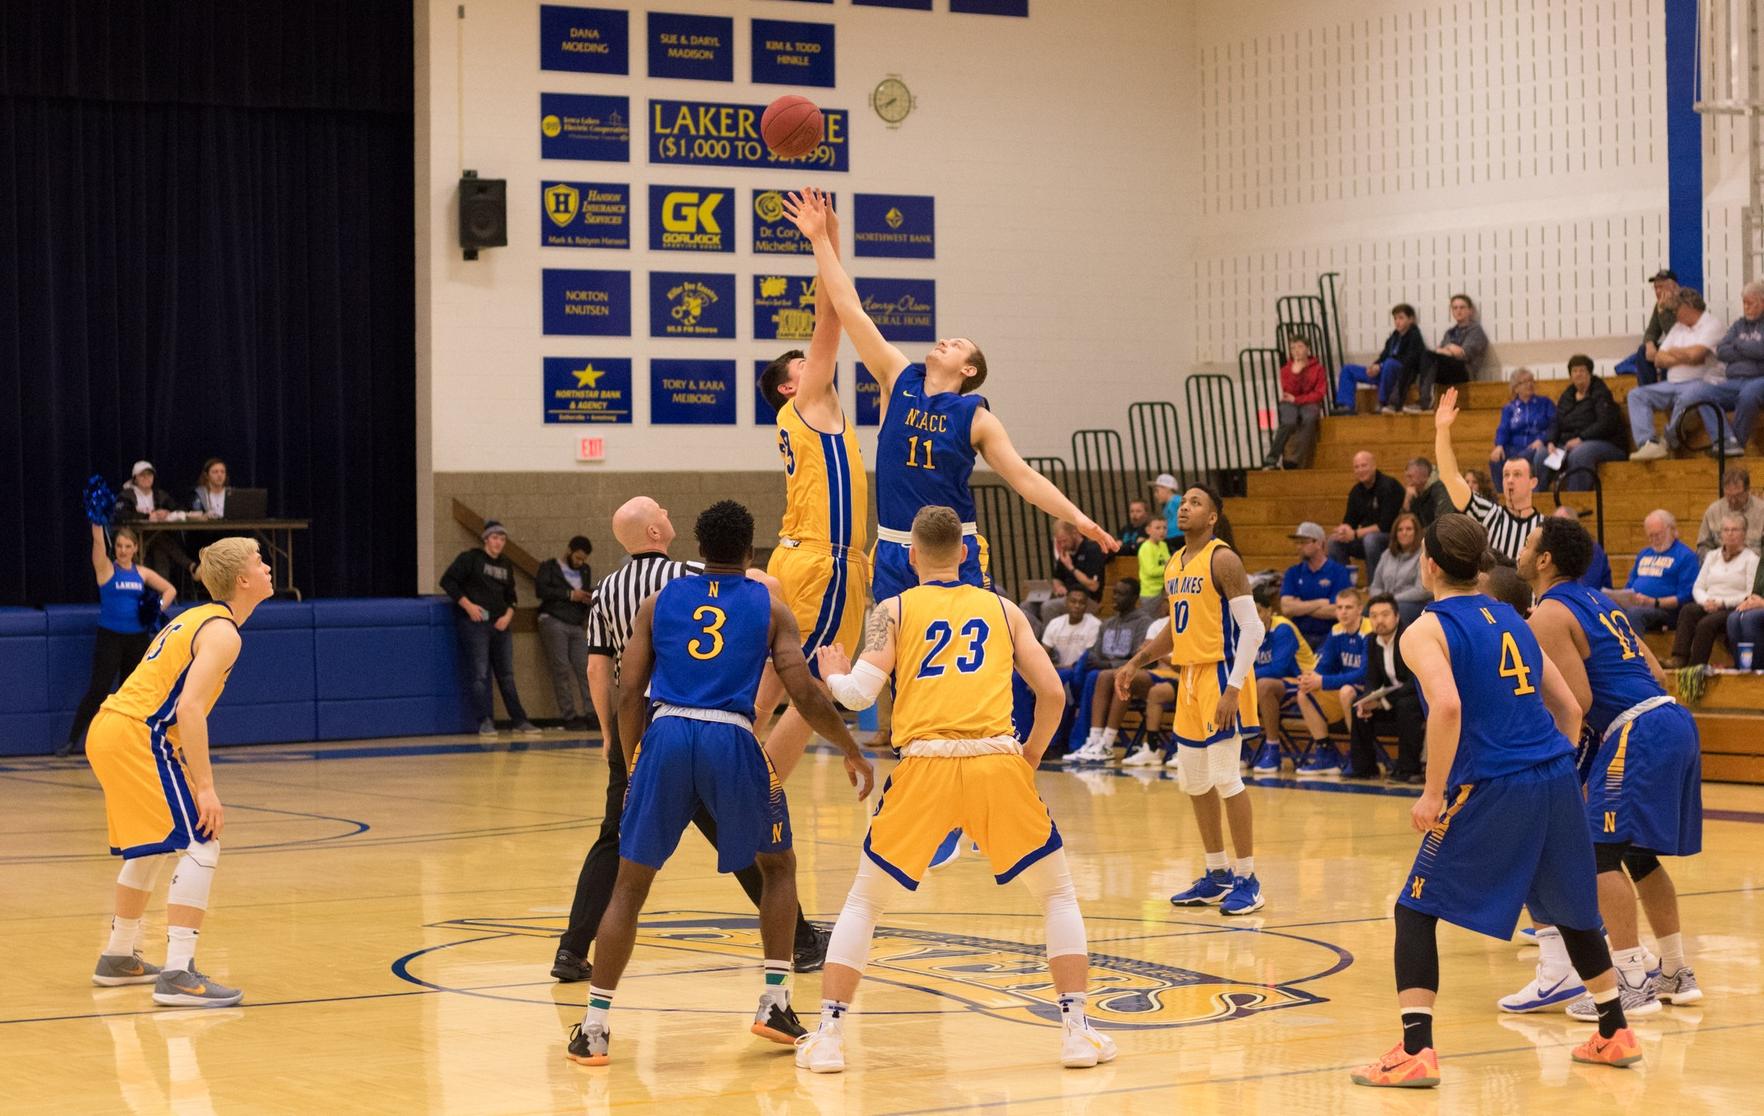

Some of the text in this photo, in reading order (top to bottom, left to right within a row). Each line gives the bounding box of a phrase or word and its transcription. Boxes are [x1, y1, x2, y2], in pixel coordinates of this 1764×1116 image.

[570, 28, 599, 39] DANA
[660, 33, 721, 47] SUE & DARYL
[561, 41, 609, 53] MOEDING
[668, 48, 714, 59] MADISON
[766, 41, 821, 53] KIM & TODD
[777, 55, 810, 66] HINKLE
[654, 104, 759, 138] LAKER
[659, 137, 731, 159] ($1,000
[734, 141, 762, 160] TO
[552, 192, 572, 214] H
[760, 226, 800, 240] Dr. Cory
[855, 232, 932, 243] NORTHWEST BANK
[755, 241, 798, 251] Michelle
[565, 291, 609, 302] NORTON
[565, 304, 609, 315] KNUTSEN
[904, 316, 932, 326] HOME
[662, 379, 726, 391] TORY & KARA
[555, 390, 622, 399] NORTHSTAR BANK
[672, 393, 716, 404] MEIBORG
[577, 401, 608, 410] AGENCY
[906, 436, 936, 469] 11
[708, 581, 720, 598] N
[1479, 608, 1496, 624] N
[687, 605, 727, 661] 3
[916, 618, 990, 681] 23
[1499, 631, 1535, 696] 4
[1603, 811, 1617, 833] N
[772, 822, 783, 843] N
[1410, 875, 1426, 900] N
